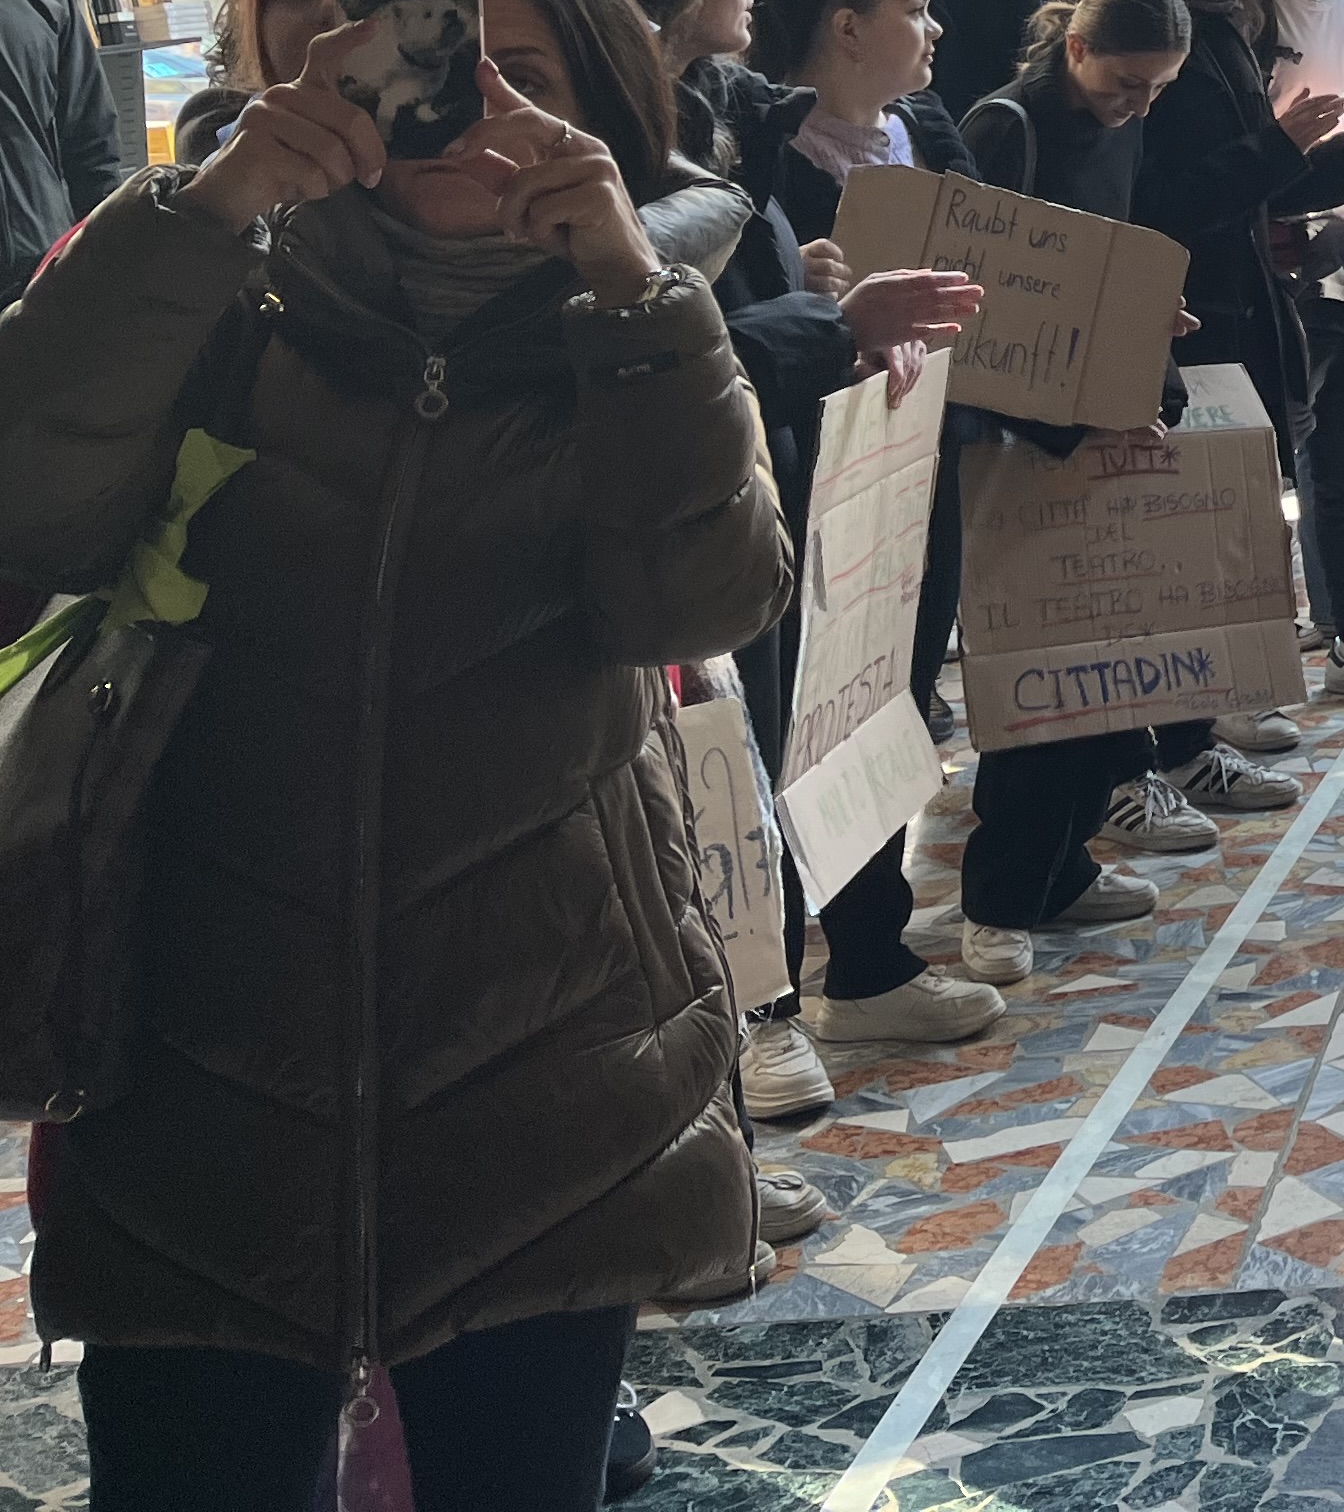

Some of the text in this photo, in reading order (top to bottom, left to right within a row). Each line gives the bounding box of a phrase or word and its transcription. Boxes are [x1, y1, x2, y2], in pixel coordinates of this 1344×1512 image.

[945, 189, 1068, 253] Raubt uns
[997, 269, 1062, 300] unsere
[1143, 488, 1237, 512] BISOGNO
[978, 602, 1021, 631] IL
[1034, 589, 1143, 624] TEATRO
[1158, 586, 1190, 605] HA
